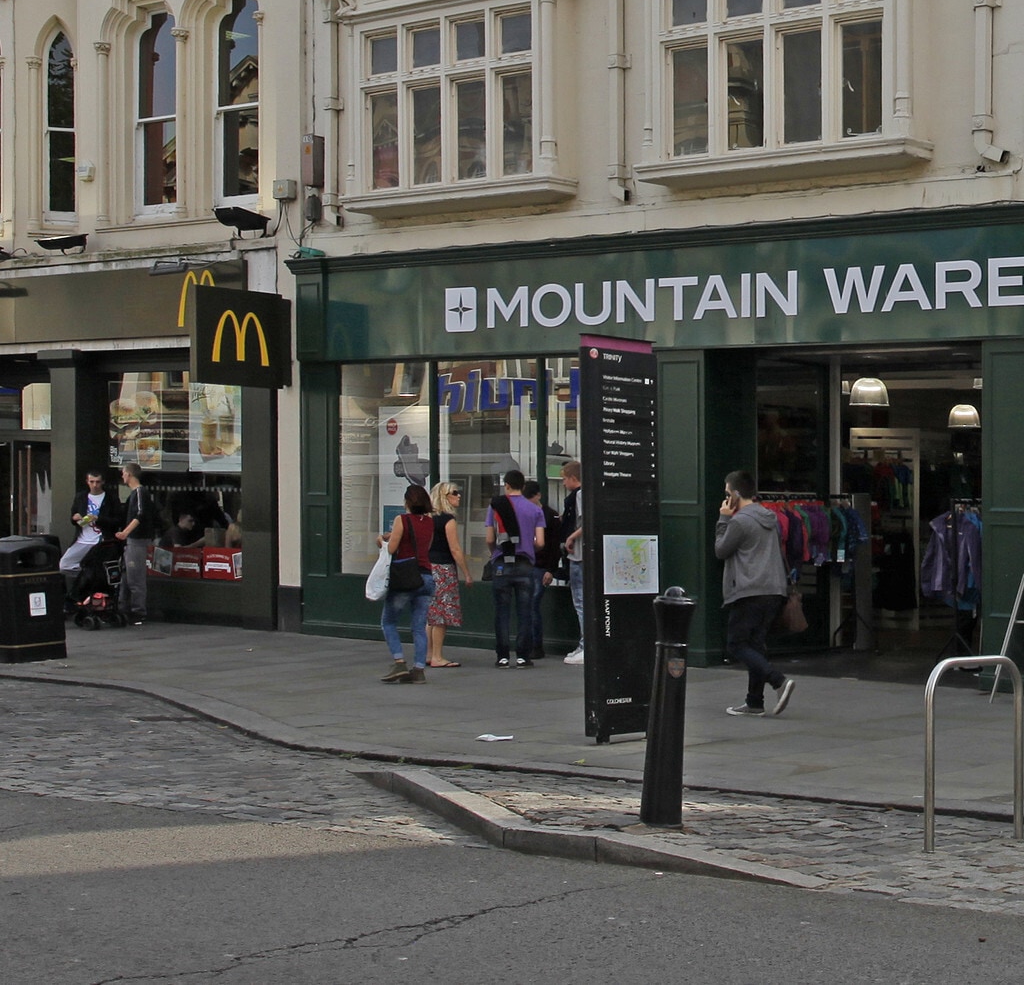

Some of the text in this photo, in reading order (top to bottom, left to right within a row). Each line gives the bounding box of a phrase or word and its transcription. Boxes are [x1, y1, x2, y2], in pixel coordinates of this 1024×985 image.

[486, 270, 798, 329] MOUNTAIN
[211, 309, 270, 367] M
[606, 697, 632, 705] COLCHESTER
